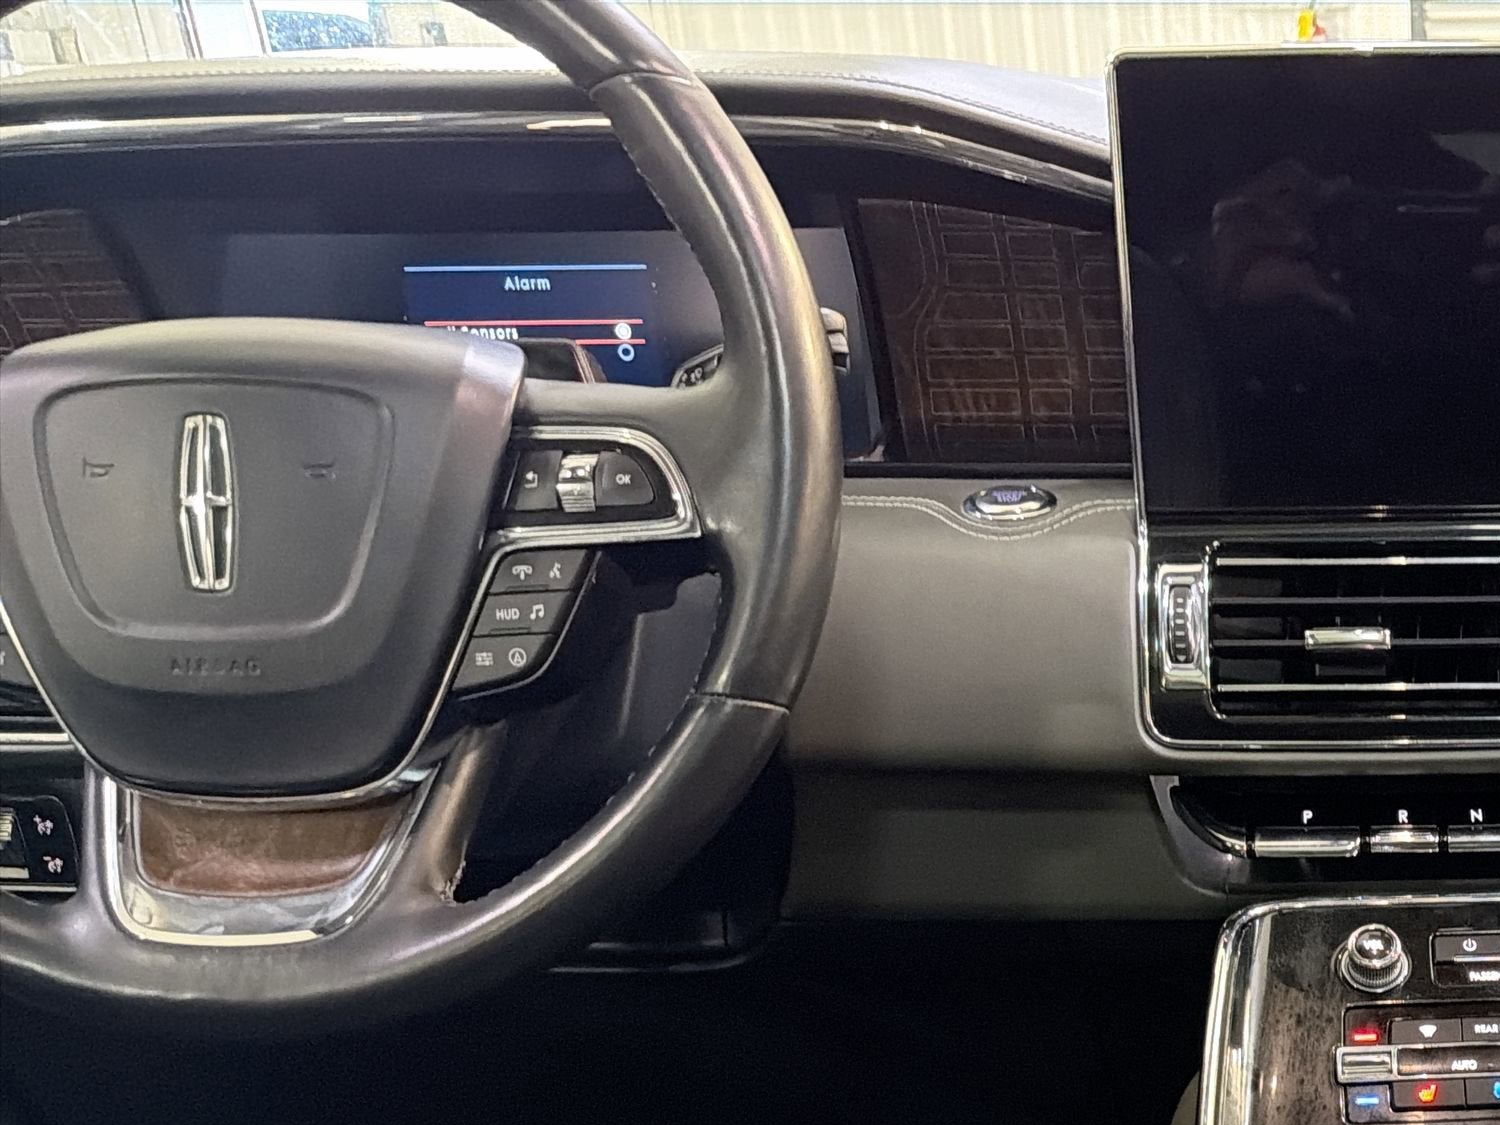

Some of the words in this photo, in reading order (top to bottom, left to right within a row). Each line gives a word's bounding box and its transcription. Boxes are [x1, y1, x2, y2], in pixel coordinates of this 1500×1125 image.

[504, 276, 551, 291] Alarm
[616, 473, 631, 485] OK
[496, 608, 519, 620] HUD
[1302, 810, 1313, 824] P
[1398, 810, 1408, 824] R
[1470, 809, 1483, 823] N
[1474, 1023, 1499, 1034] REAR
[1451, 1059, 1478, 1071] AUTO
